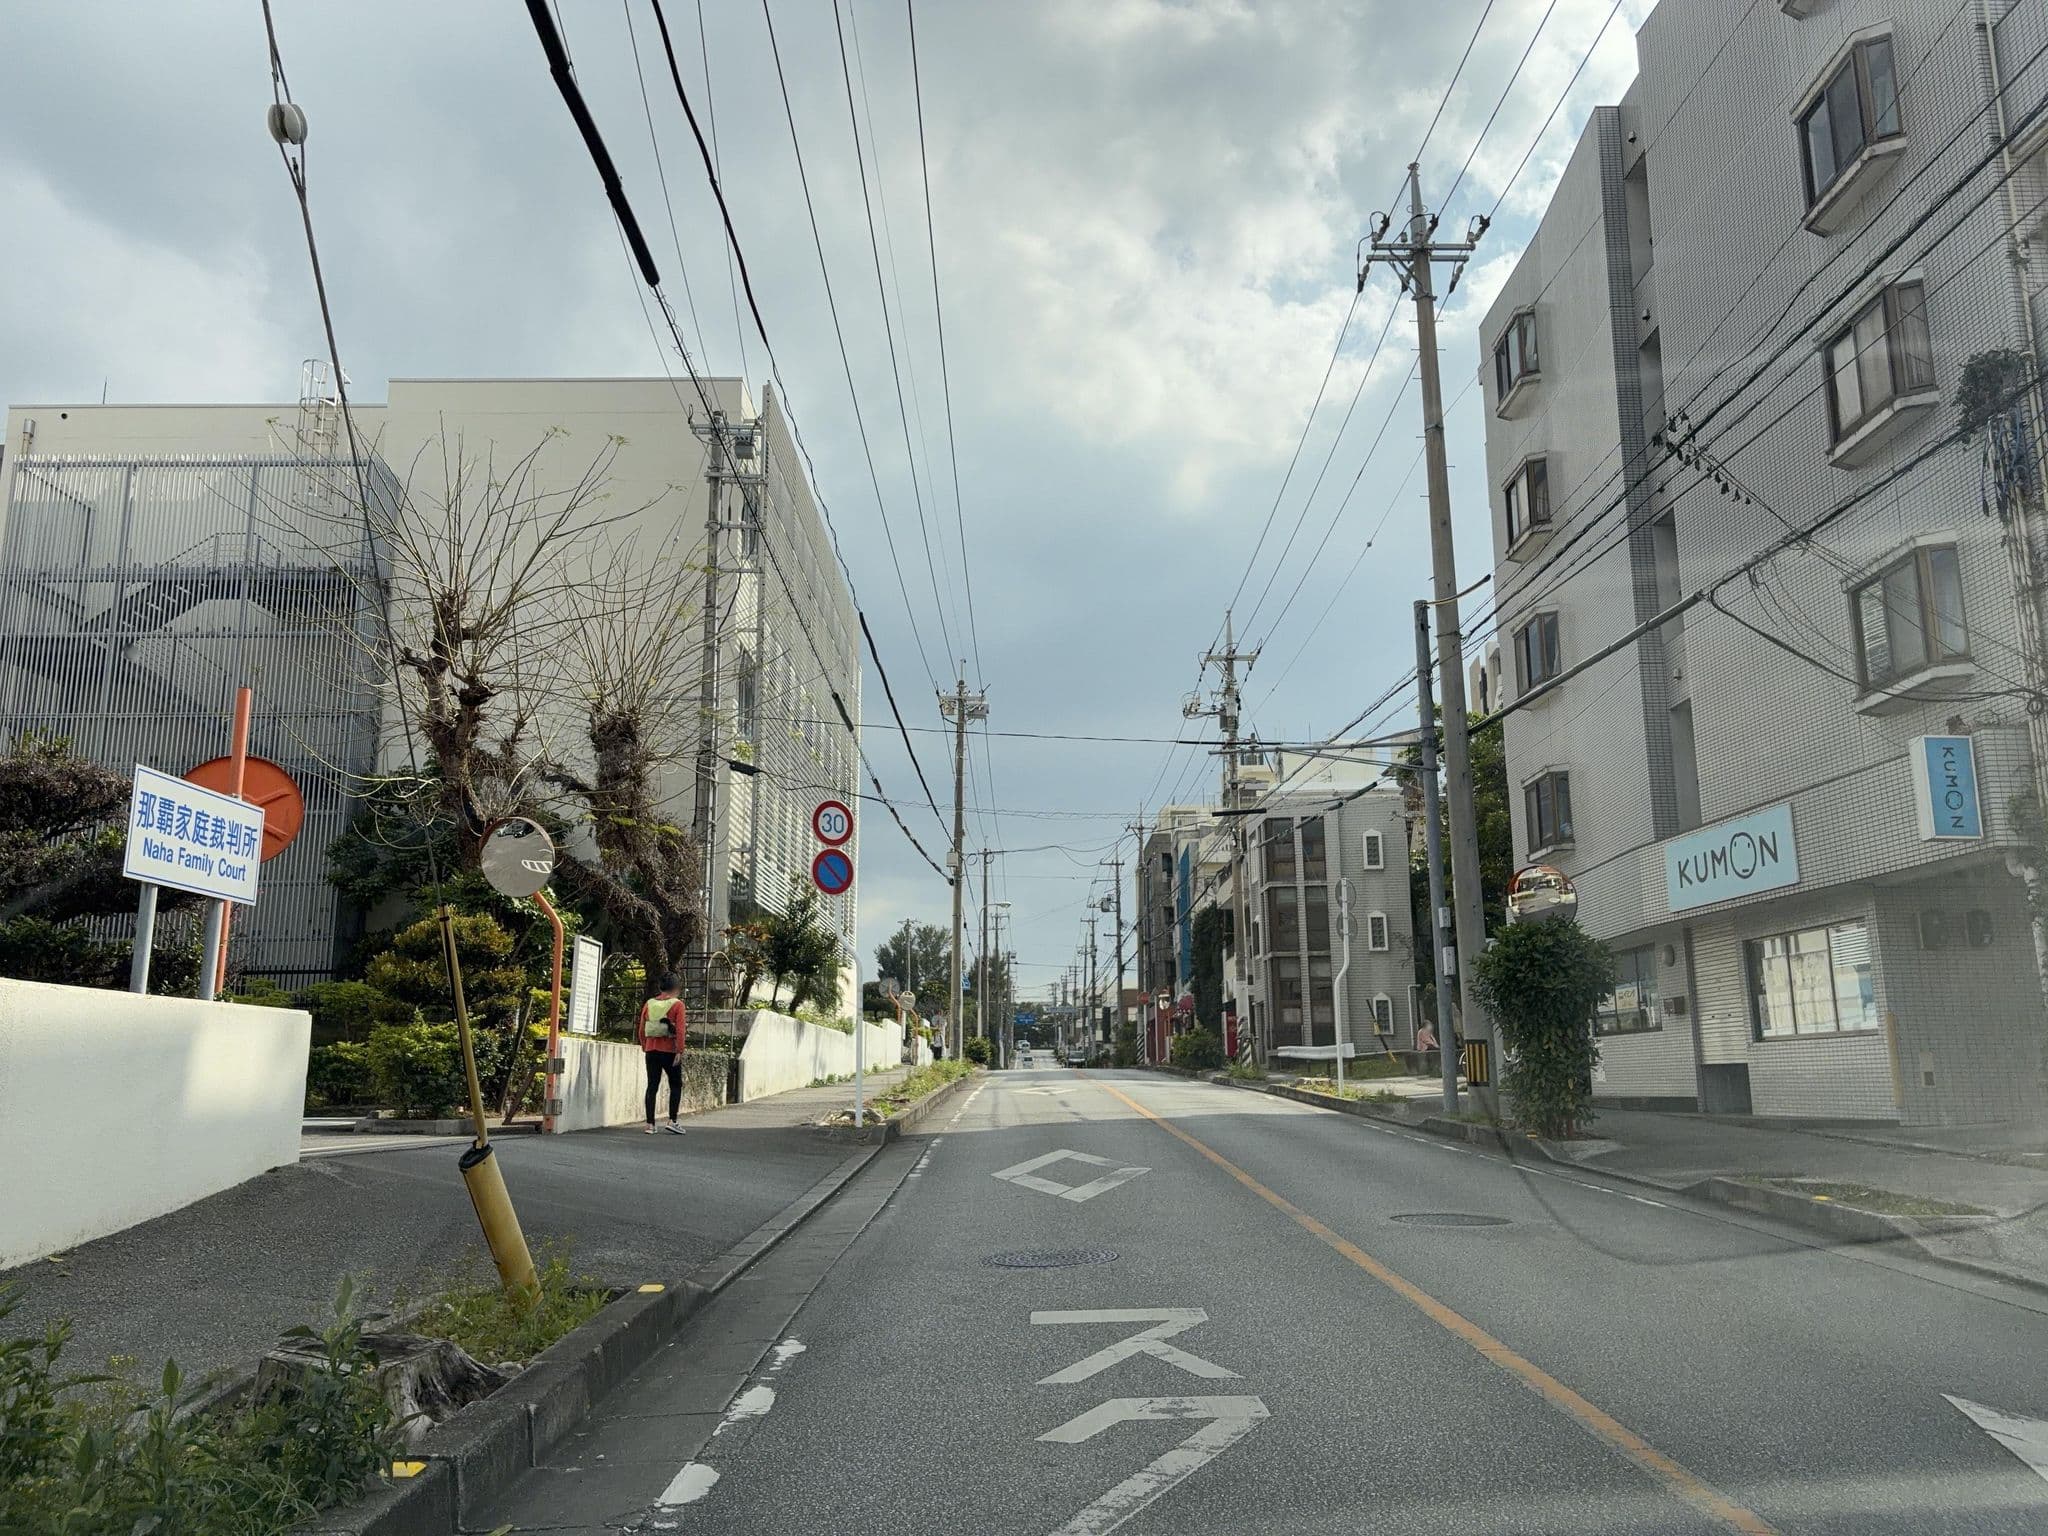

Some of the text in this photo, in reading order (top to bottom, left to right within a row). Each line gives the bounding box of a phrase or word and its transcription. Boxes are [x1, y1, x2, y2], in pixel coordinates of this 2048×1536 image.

[1942, 746, 1965, 828] KUMON
[136, 791, 258, 860] 那覇家庭裁判所
[821, 813, 845, 834] 30
[142, 837, 246, 882] Naha Family Court
[1678, 831, 1778, 888] KUMON
